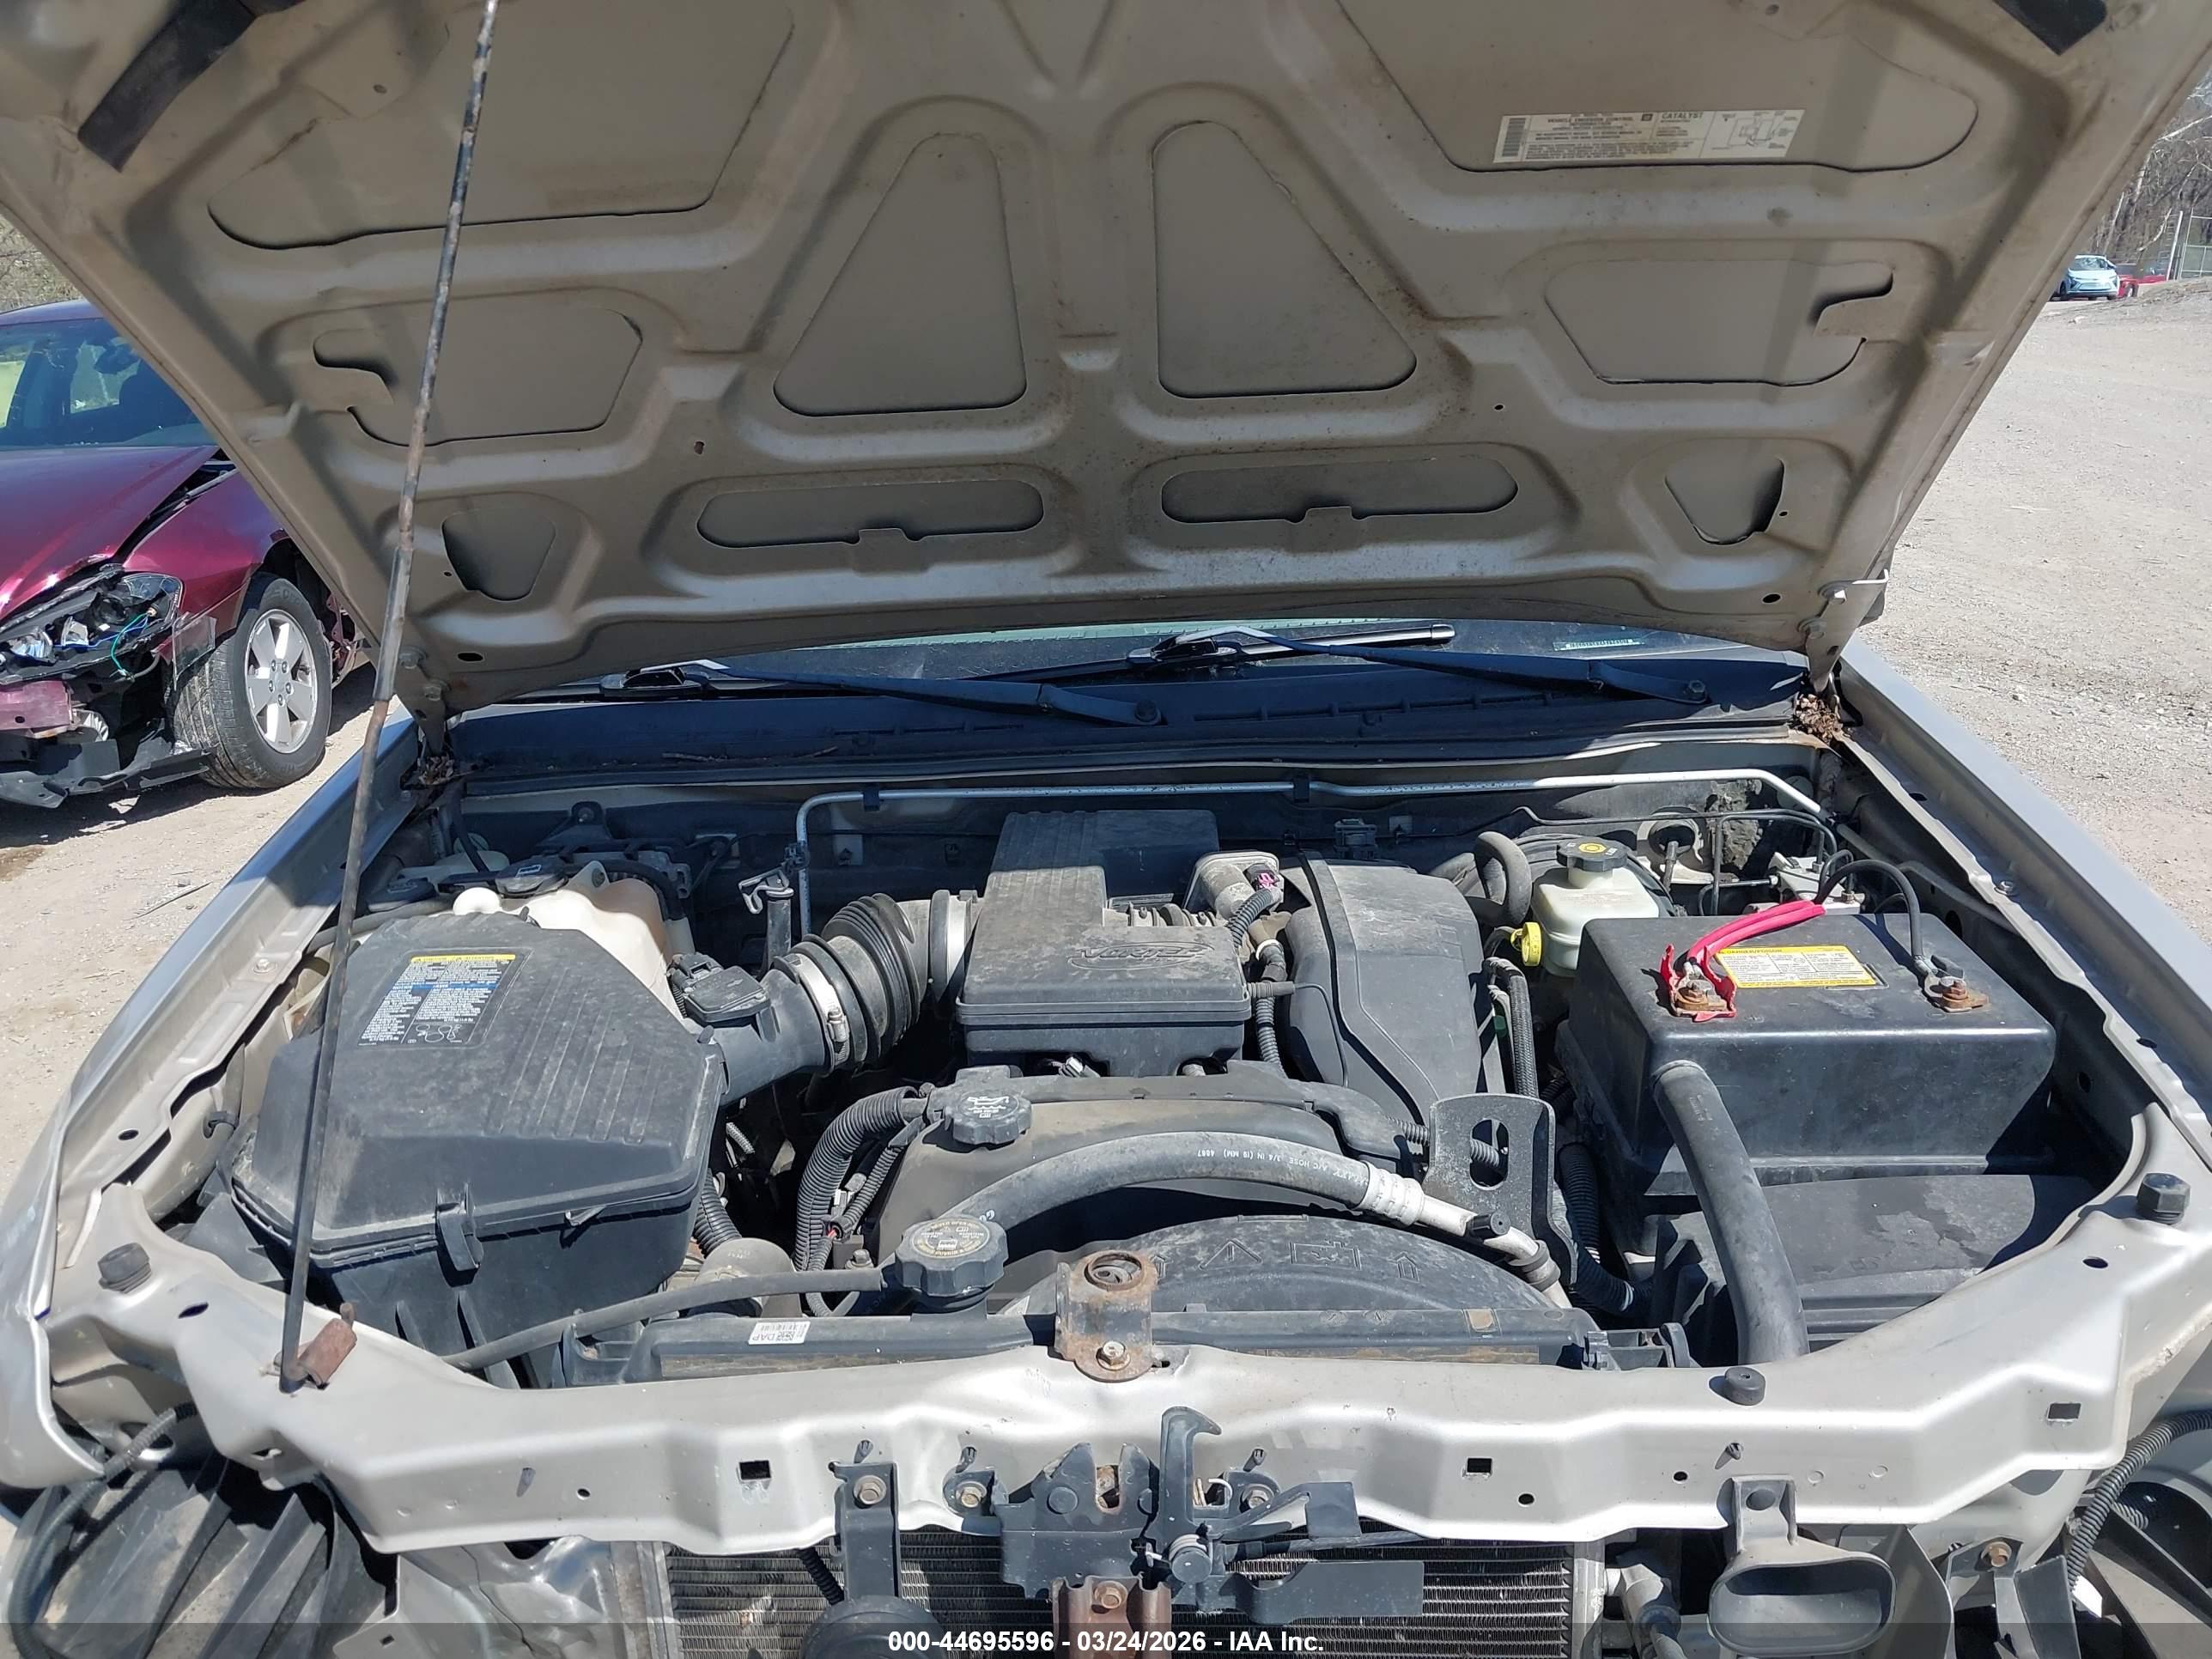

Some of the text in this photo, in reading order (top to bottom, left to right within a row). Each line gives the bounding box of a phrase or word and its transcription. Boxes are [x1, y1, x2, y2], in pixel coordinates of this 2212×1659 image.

[1224, 1149, 1239, 1158] MM)
[1268, 1154, 1281, 1163] 3/4
[1289, 1158, 1310, 1168] HOSE
